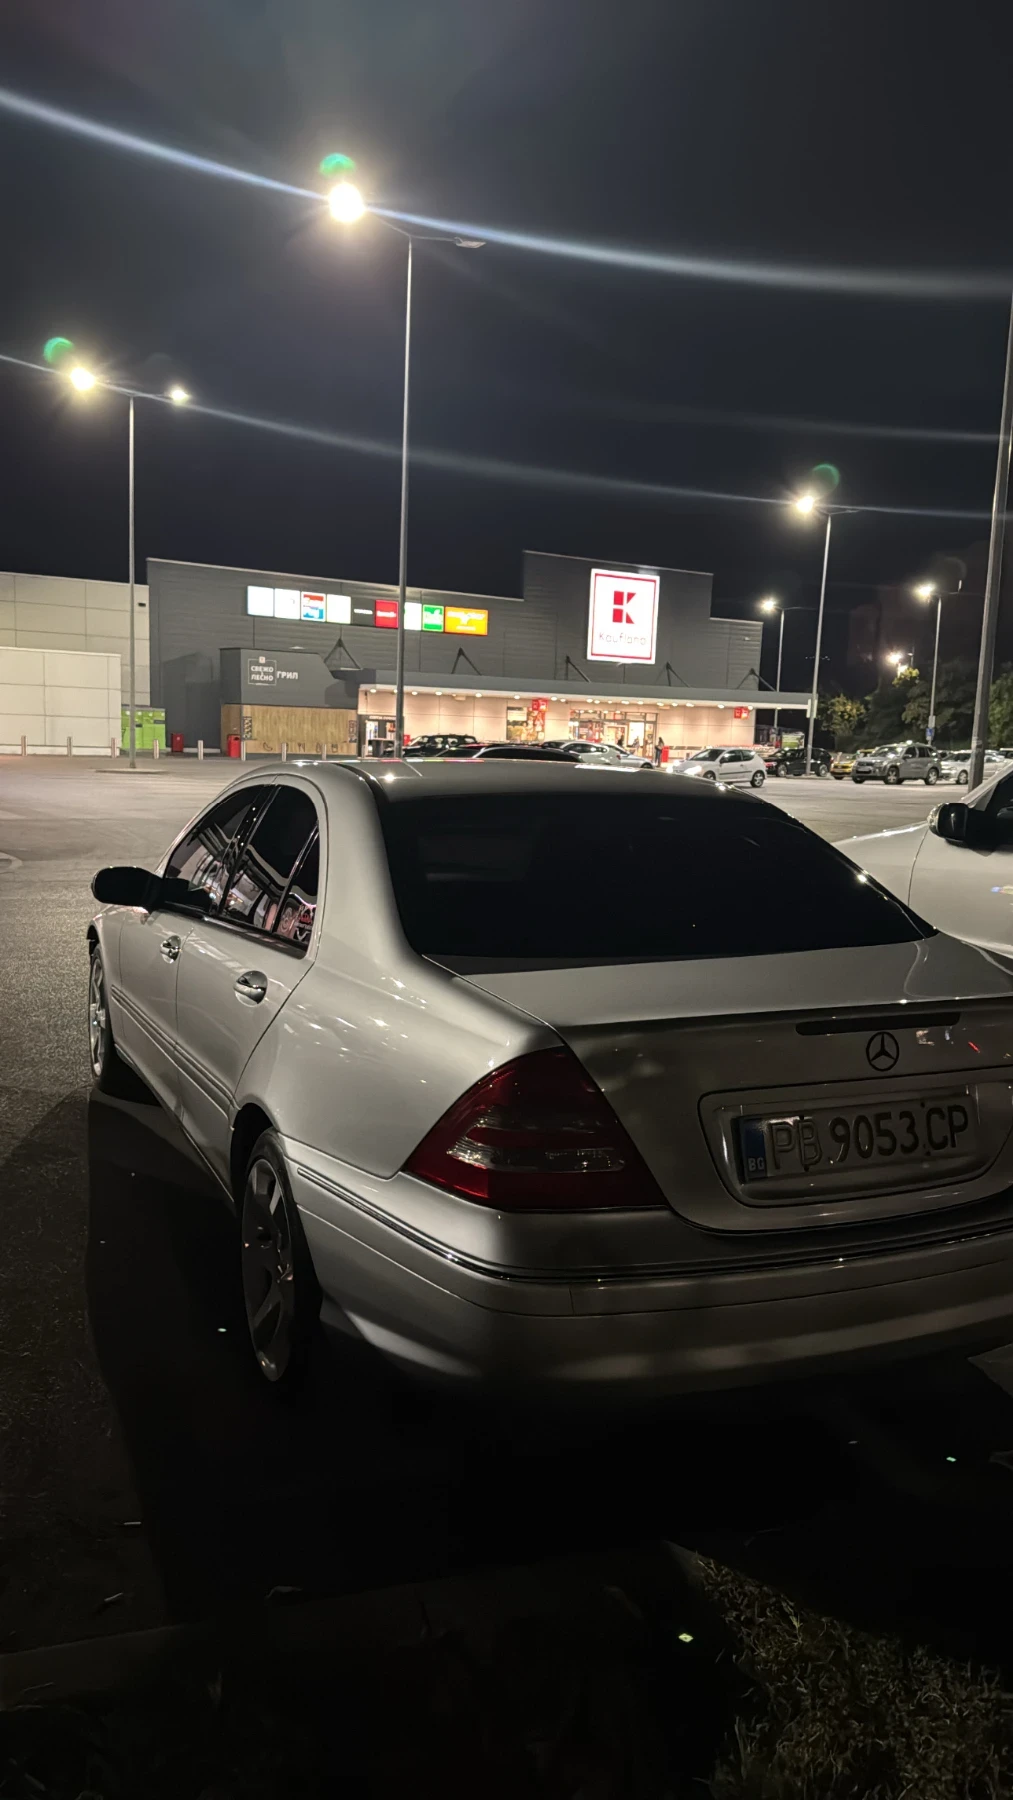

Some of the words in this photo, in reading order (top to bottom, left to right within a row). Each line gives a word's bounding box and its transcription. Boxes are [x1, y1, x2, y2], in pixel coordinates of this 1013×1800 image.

[251, 674, 274, 682] ЛЕСНО
[276, 670, 299, 679] ГРИЛ
[829, 1110, 919, 1163] 9053
[926, 1104, 969, 1150] CP
[748, 1157, 765, 1171] BG
